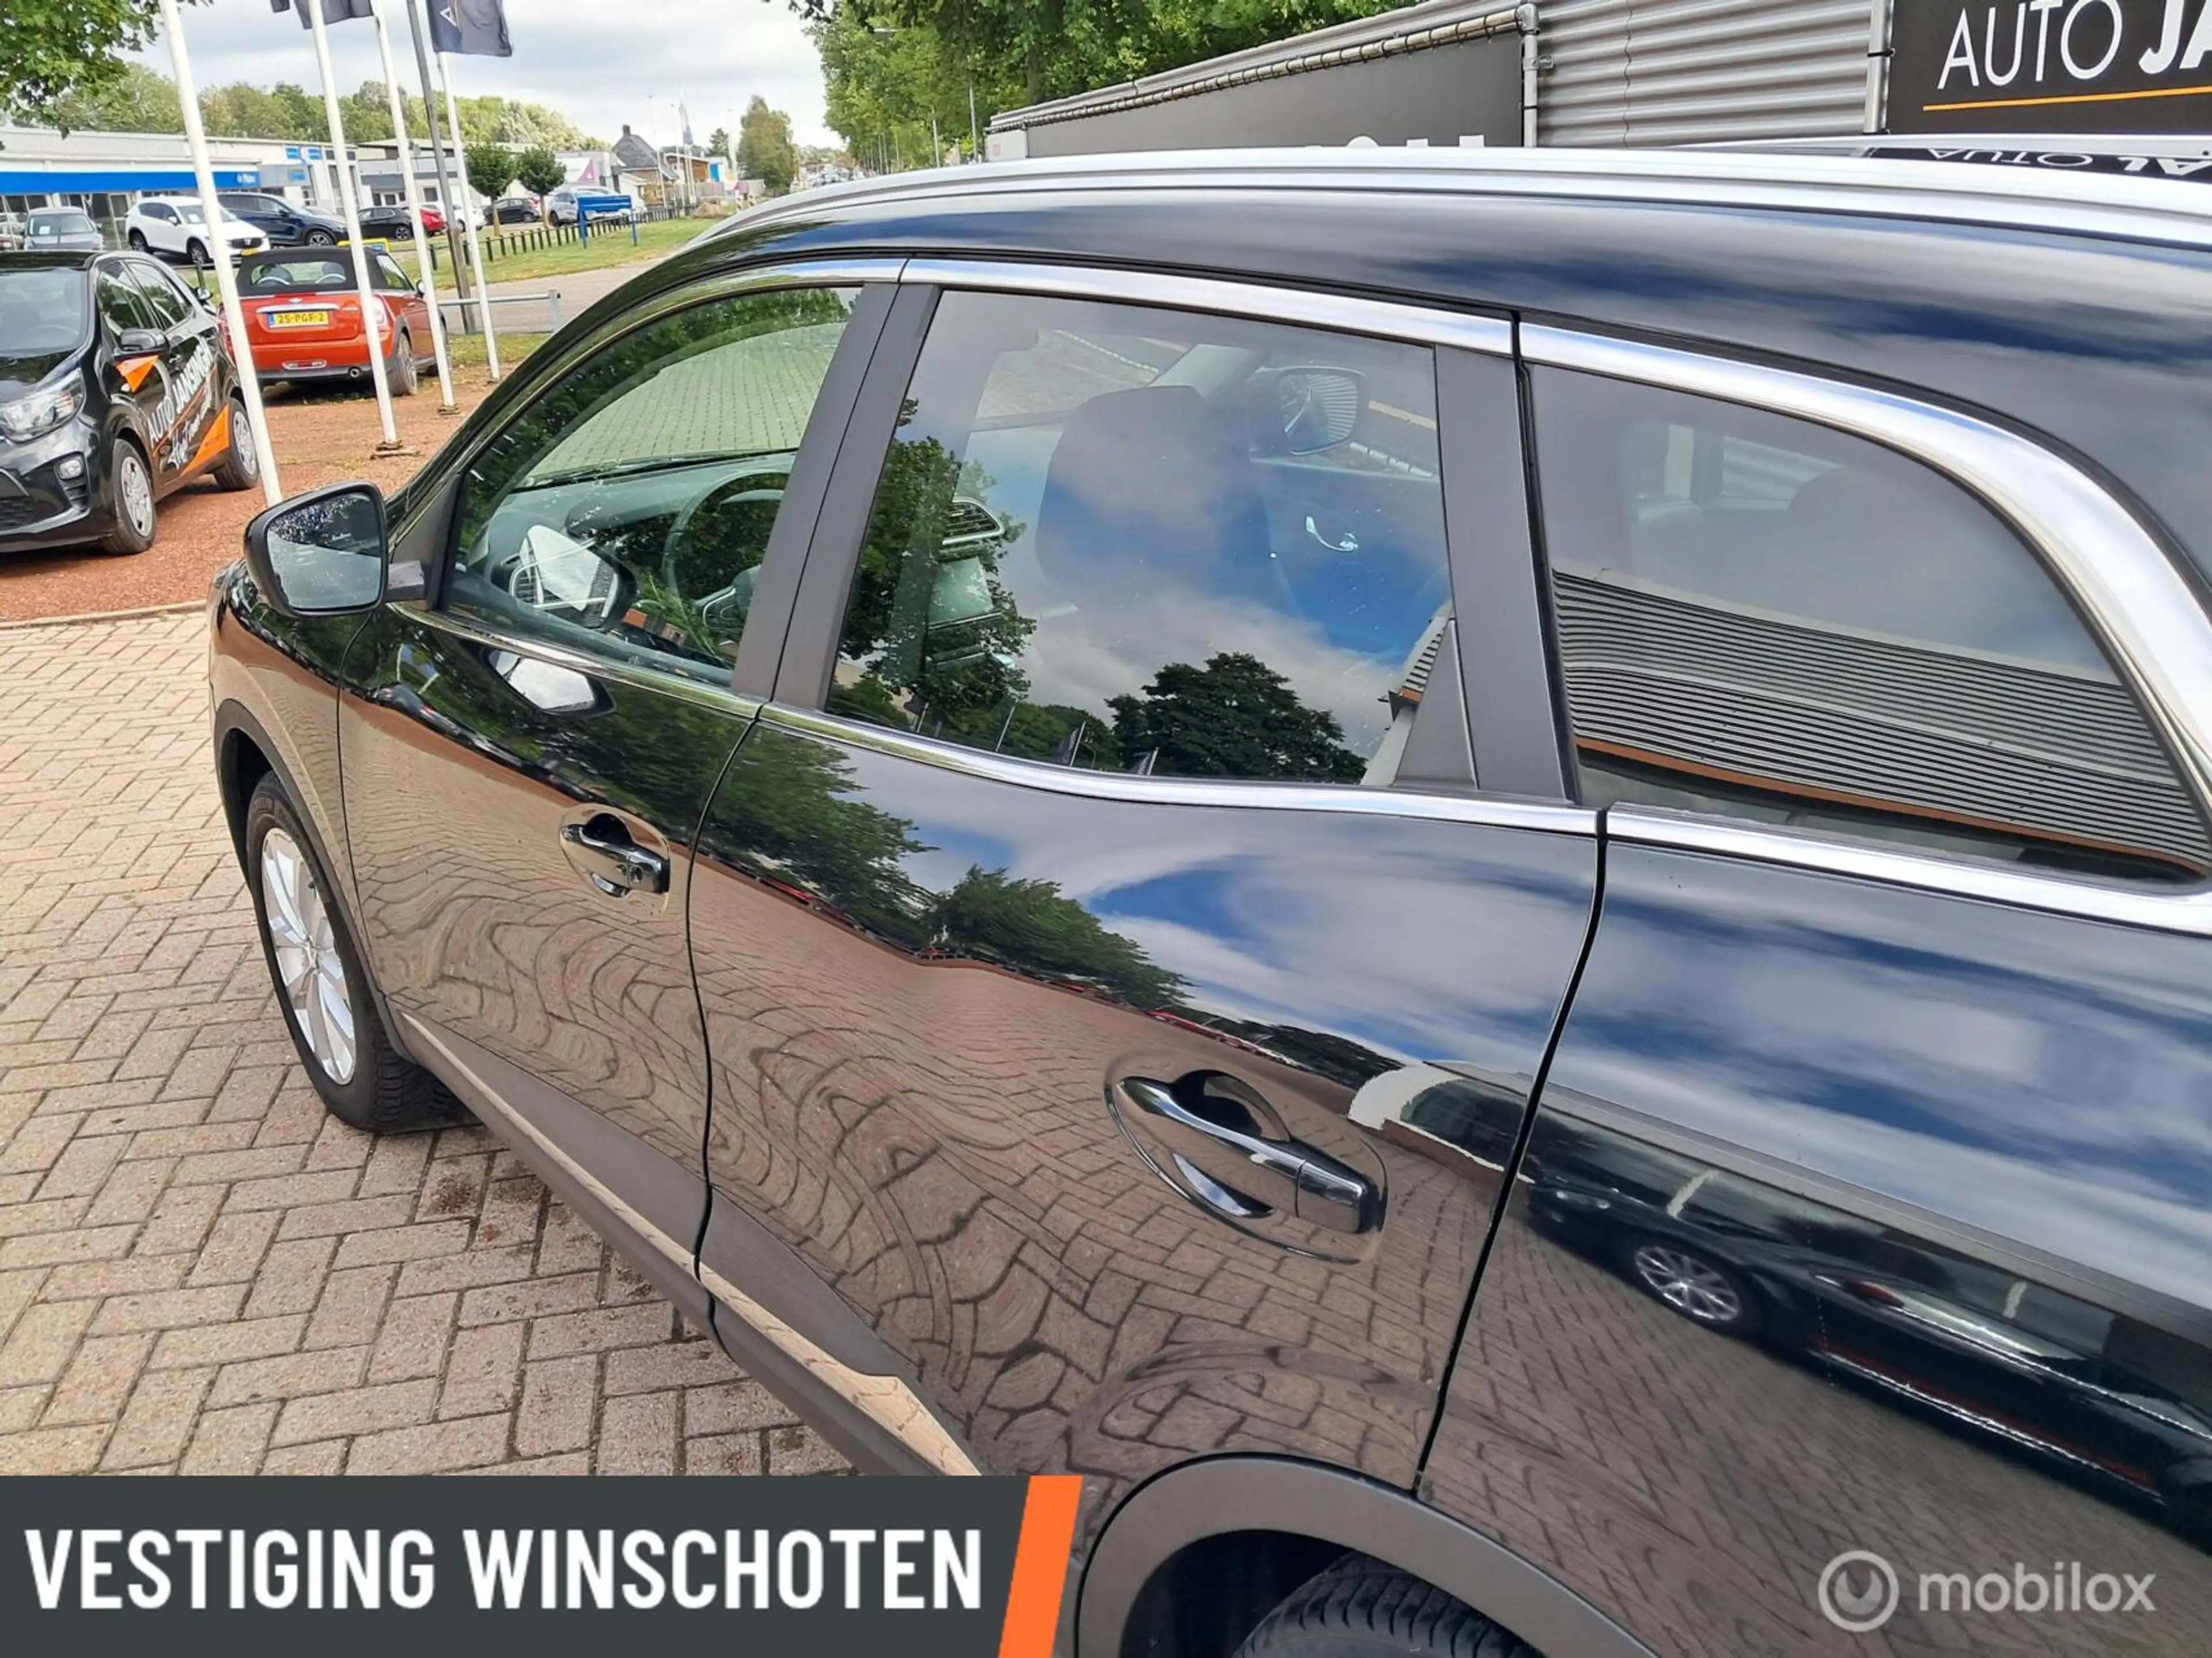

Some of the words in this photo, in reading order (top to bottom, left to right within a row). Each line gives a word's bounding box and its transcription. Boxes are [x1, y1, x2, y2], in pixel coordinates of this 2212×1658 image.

[1937, 0, 2123, 89] AUTO
[277, 313, 324, 324] 25-PGF-2
[147, 396, 175, 449] AUTO
